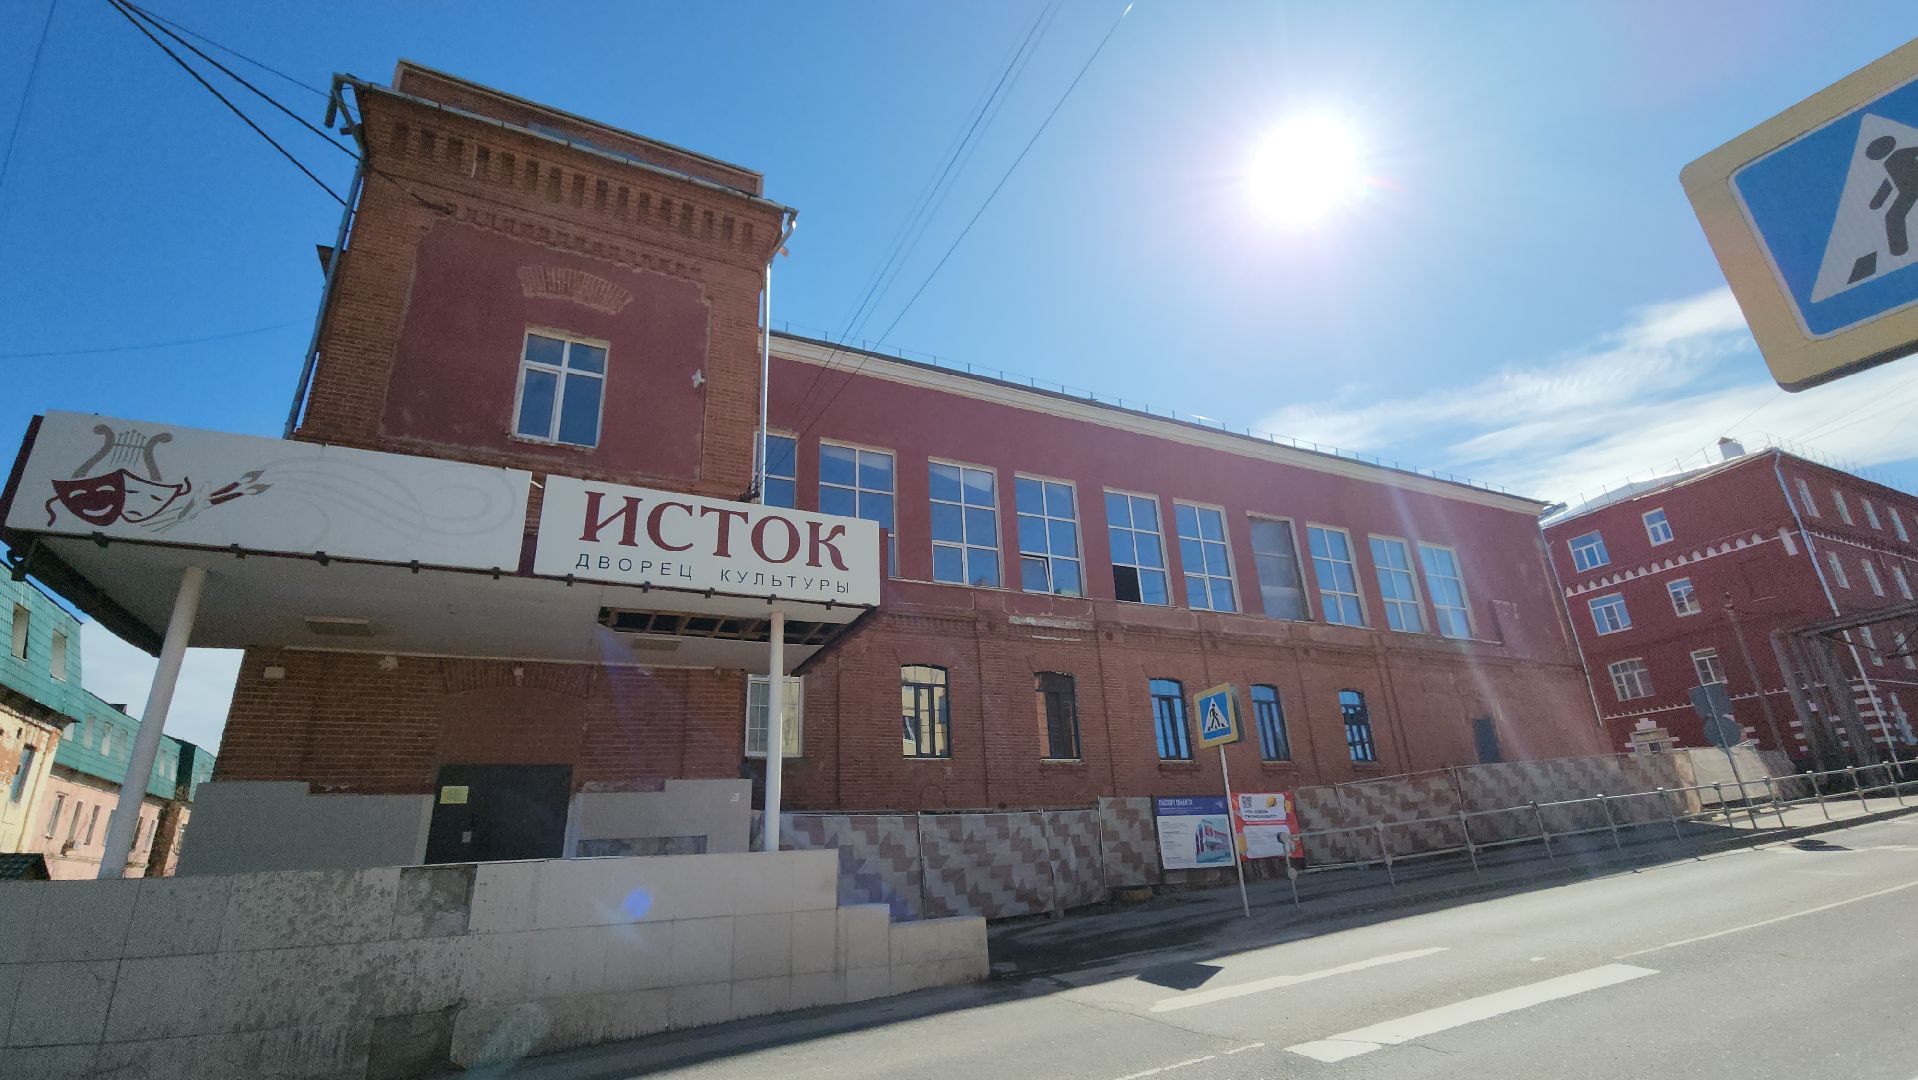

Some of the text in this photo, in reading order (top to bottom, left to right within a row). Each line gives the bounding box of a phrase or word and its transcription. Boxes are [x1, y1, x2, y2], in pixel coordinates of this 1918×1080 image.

[579, 490, 849, 571] ИСТОК
[575, 553, 849, 593] ДВОРЕЦ КУЛЬТУРЫ
